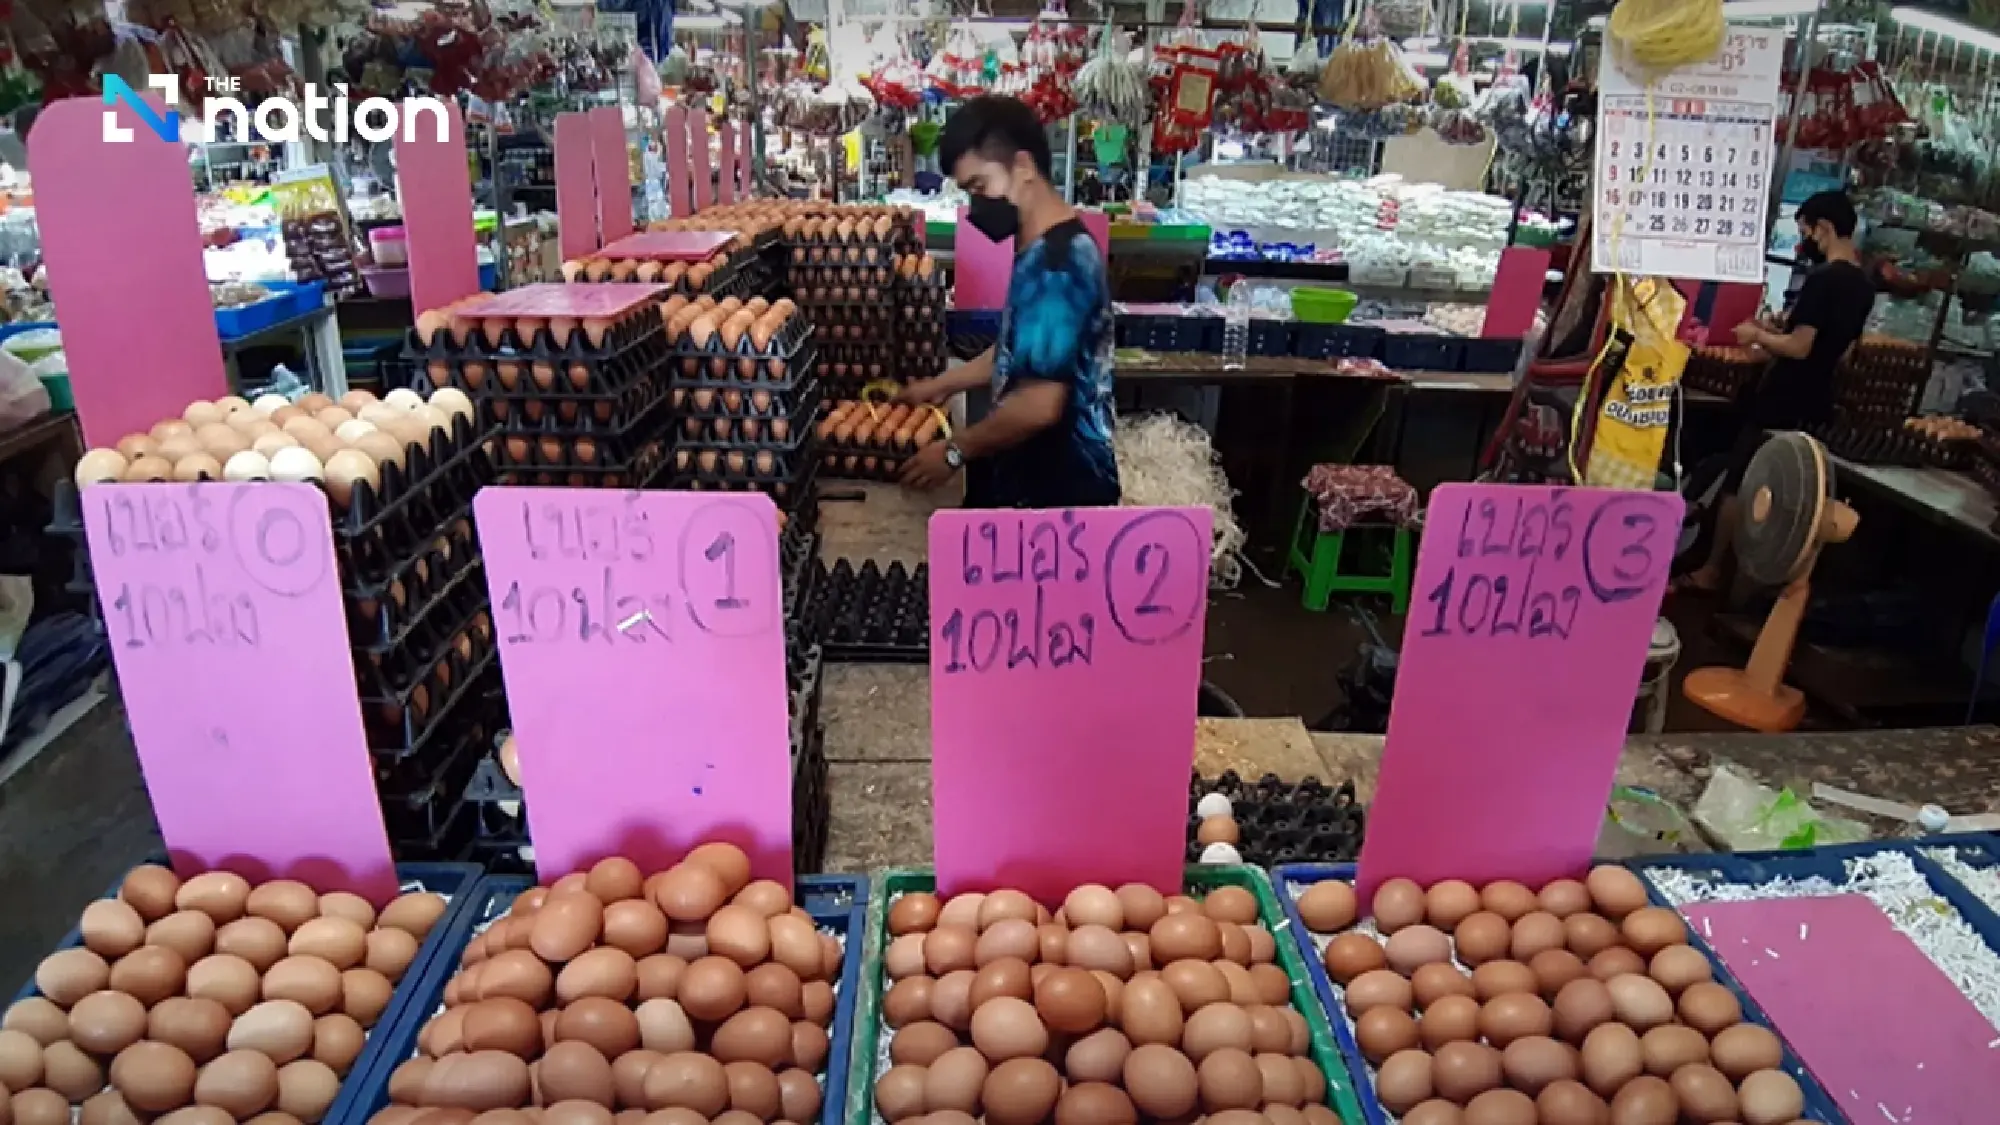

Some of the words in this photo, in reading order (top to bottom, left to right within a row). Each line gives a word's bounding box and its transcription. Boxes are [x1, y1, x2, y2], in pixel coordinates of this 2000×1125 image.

[1611, 142, 1620, 157] 2
[1634, 142, 1643, 159] 3
[1657, 143, 1666, 160] 4
[1682, 145, 1689, 162] 5
[1705, 146, 1712, 163] 6
[1728, 148, 1737, 163] 7
[1751, 150, 1759, 166] 8
[1609, 165, 1617, 180] 9
[1654, 168, 1666, 183] 11
[1677, 169, 1692, 185] 12
[1700, 171, 1714, 187] 13
[1722, 172, 1737, 187] 14
[1746, 174, 1760, 189] 15
[1606, 189, 1620, 205] 16
[1651, 191, 1666, 208] 18
[1674, 192, 1689, 209] 19
[1697, 194, 1712, 209] 20
[1720, 195, 1734, 211] 21
[1742, 197, 1757, 213] 22
[1650, 215, 1665, 231] 25
[1672, 216, 1688, 232] 26
[1695, 217, 1710, 234] 27
[1717, 220, 1732, 235] 28
[1740, 221, 1755, 237] 29
[1457, 490, 1574, 561] เบอร์
[1612, 513, 1658, 582] 3
[704, 530, 749, 609] 1
[962, 509, 1090, 585] เบอร์
[1134, 542, 1175, 616] 2
